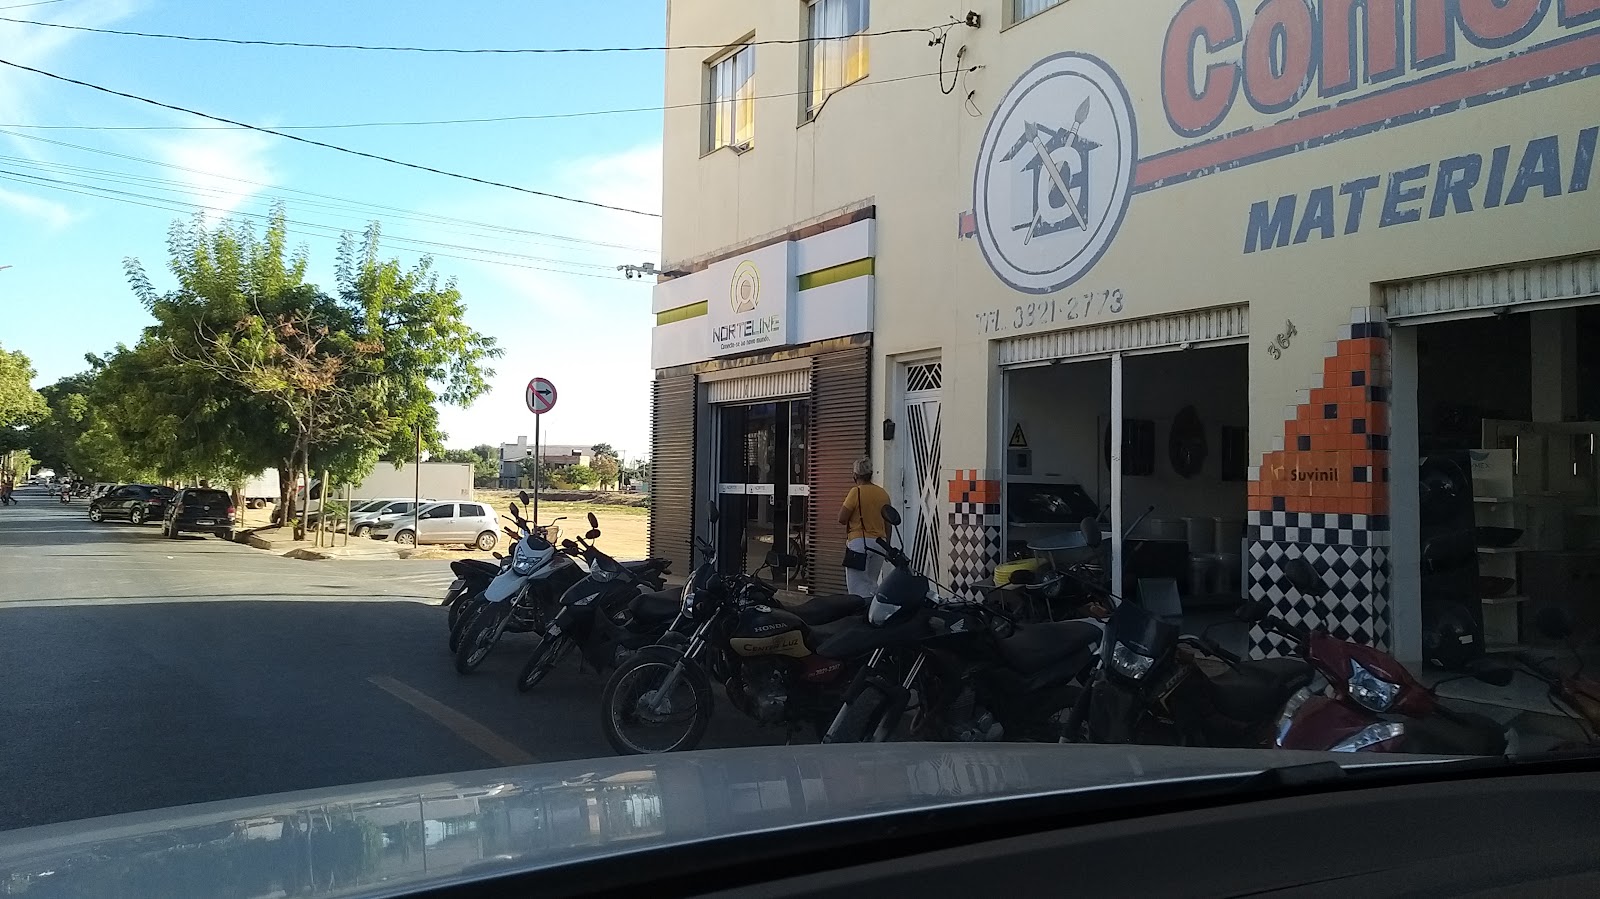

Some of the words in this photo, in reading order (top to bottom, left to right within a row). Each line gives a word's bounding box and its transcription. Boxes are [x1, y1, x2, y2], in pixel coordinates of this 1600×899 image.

[712, 314, 780, 343] NORTELINE
[1291, 467, 1339, 481] Suvinil
[754, 622, 788, 633] HONDA
